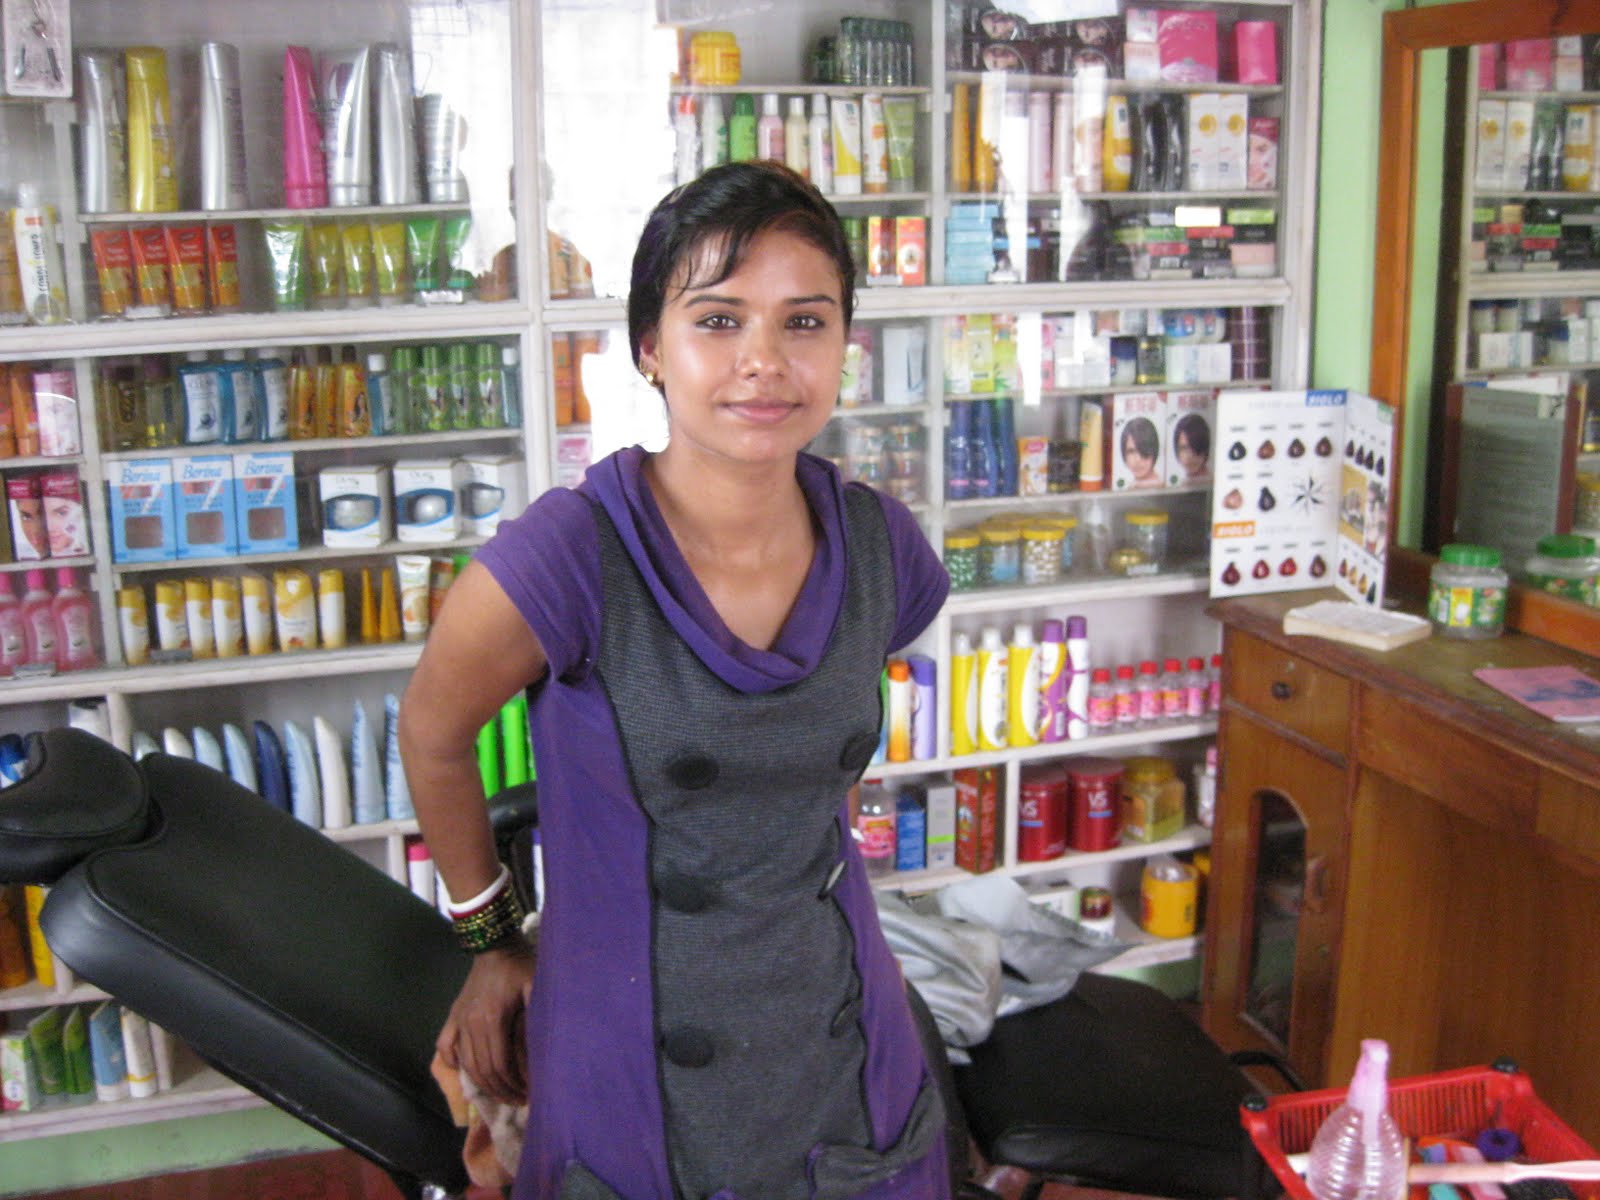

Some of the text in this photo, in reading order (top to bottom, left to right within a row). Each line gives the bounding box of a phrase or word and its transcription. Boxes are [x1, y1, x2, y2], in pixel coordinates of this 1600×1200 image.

[121, 467, 162, 483] Berina
[183, 464, 222, 480] Berina
[244, 460, 284, 475] Berina
